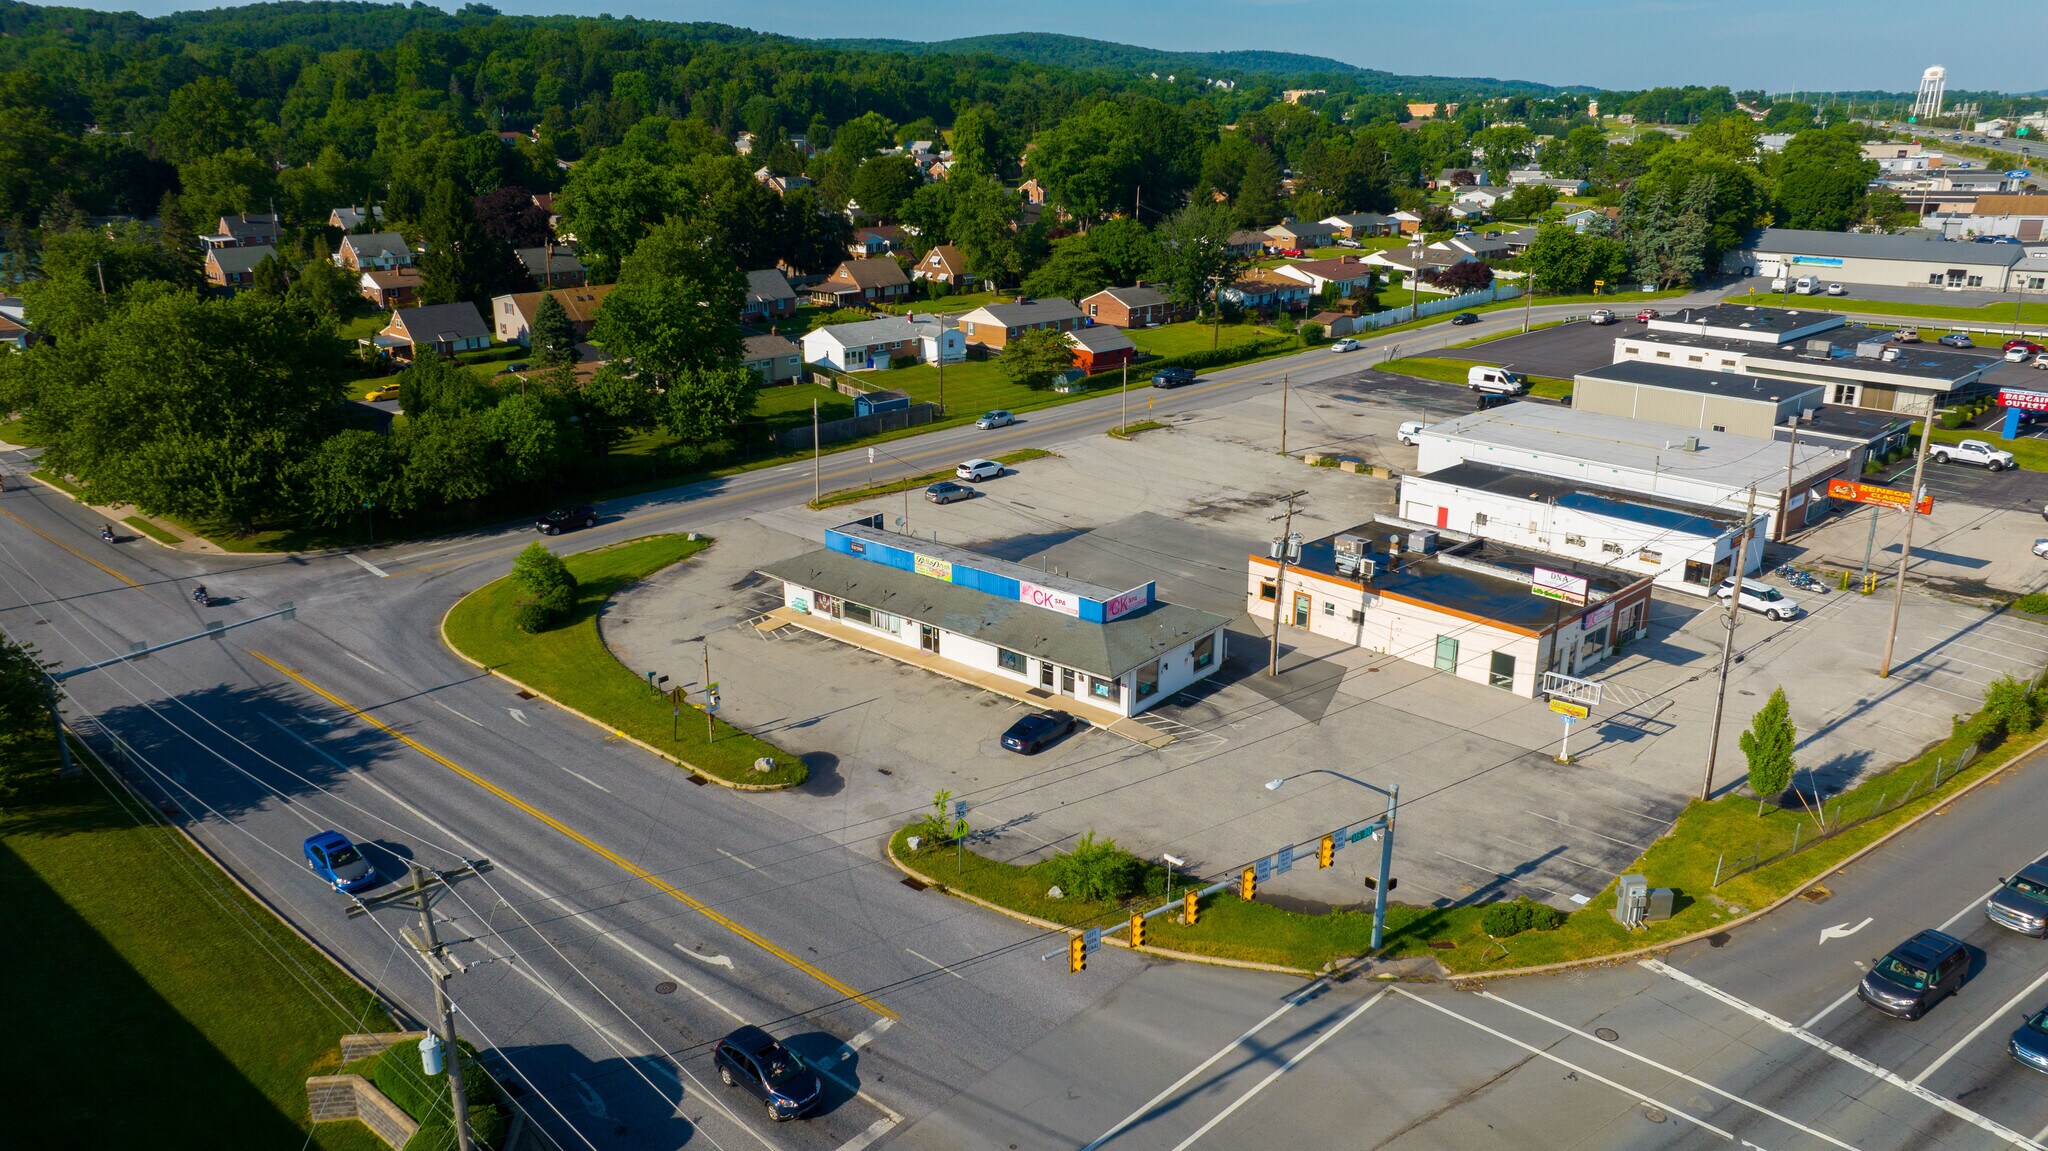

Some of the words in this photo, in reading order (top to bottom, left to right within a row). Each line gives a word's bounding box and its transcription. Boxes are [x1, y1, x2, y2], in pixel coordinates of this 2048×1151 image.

[2005, 400, 2047, 410] OUTLET
[1860, 485, 1929, 503] RENEGAE
[1871, 493, 1912, 504] CLASSIC
[1551, 572, 1569, 583] DNA
[1033, 590, 1055, 608] CK
[1054, 598, 1066, 606] SPA
[1111, 597, 1128, 615] CK
[1353, 832, 1362, 842] US
[1364, 827, 1373, 838] 30
